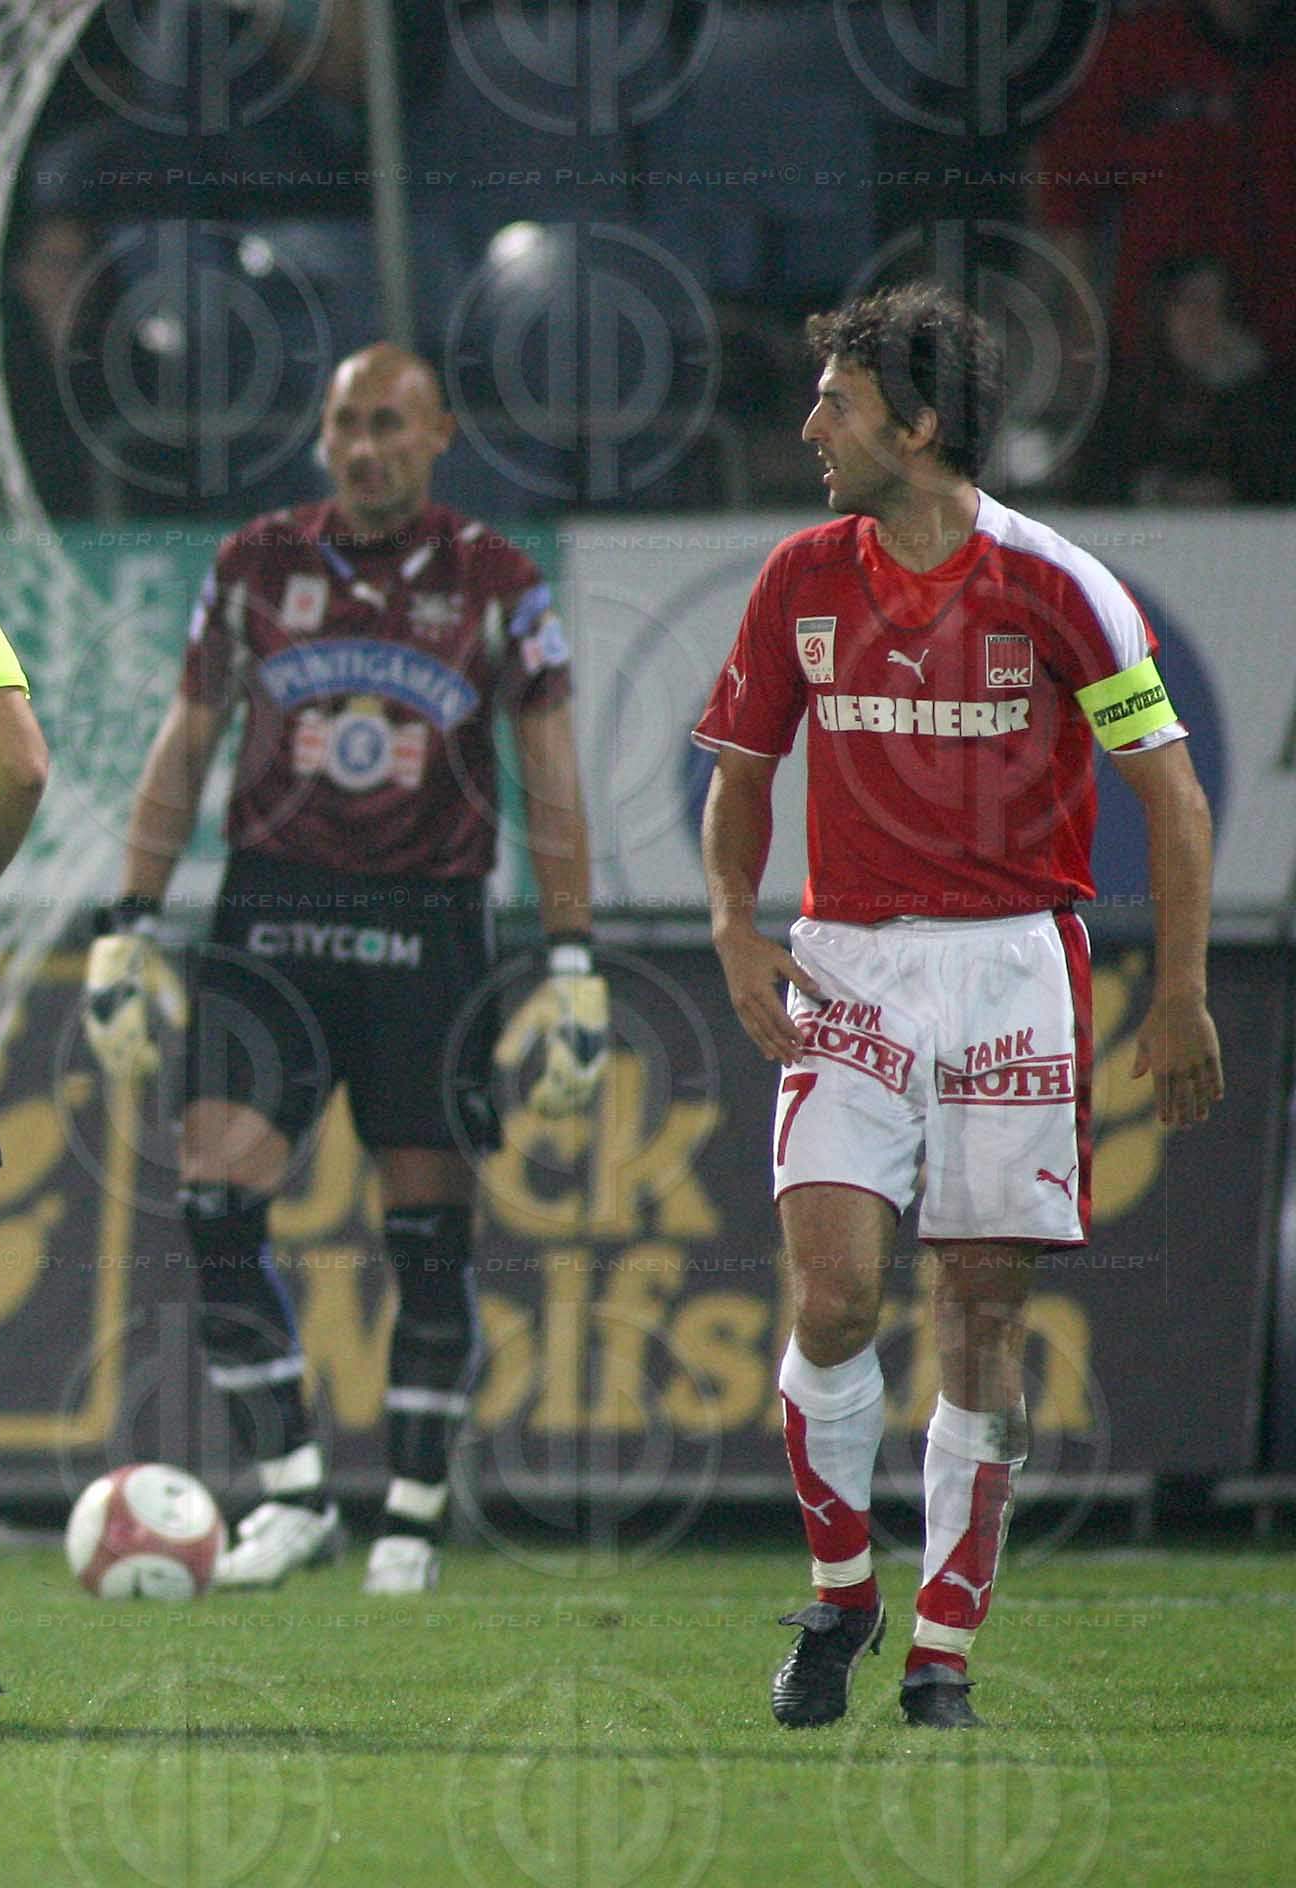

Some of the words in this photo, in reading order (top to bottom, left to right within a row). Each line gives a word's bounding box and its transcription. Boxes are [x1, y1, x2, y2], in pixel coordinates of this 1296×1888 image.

[989, 667, 1030, 685] GAK
[963, 1026, 1036, 1073] TANK
[776, 1072, 818, 1166] 7
